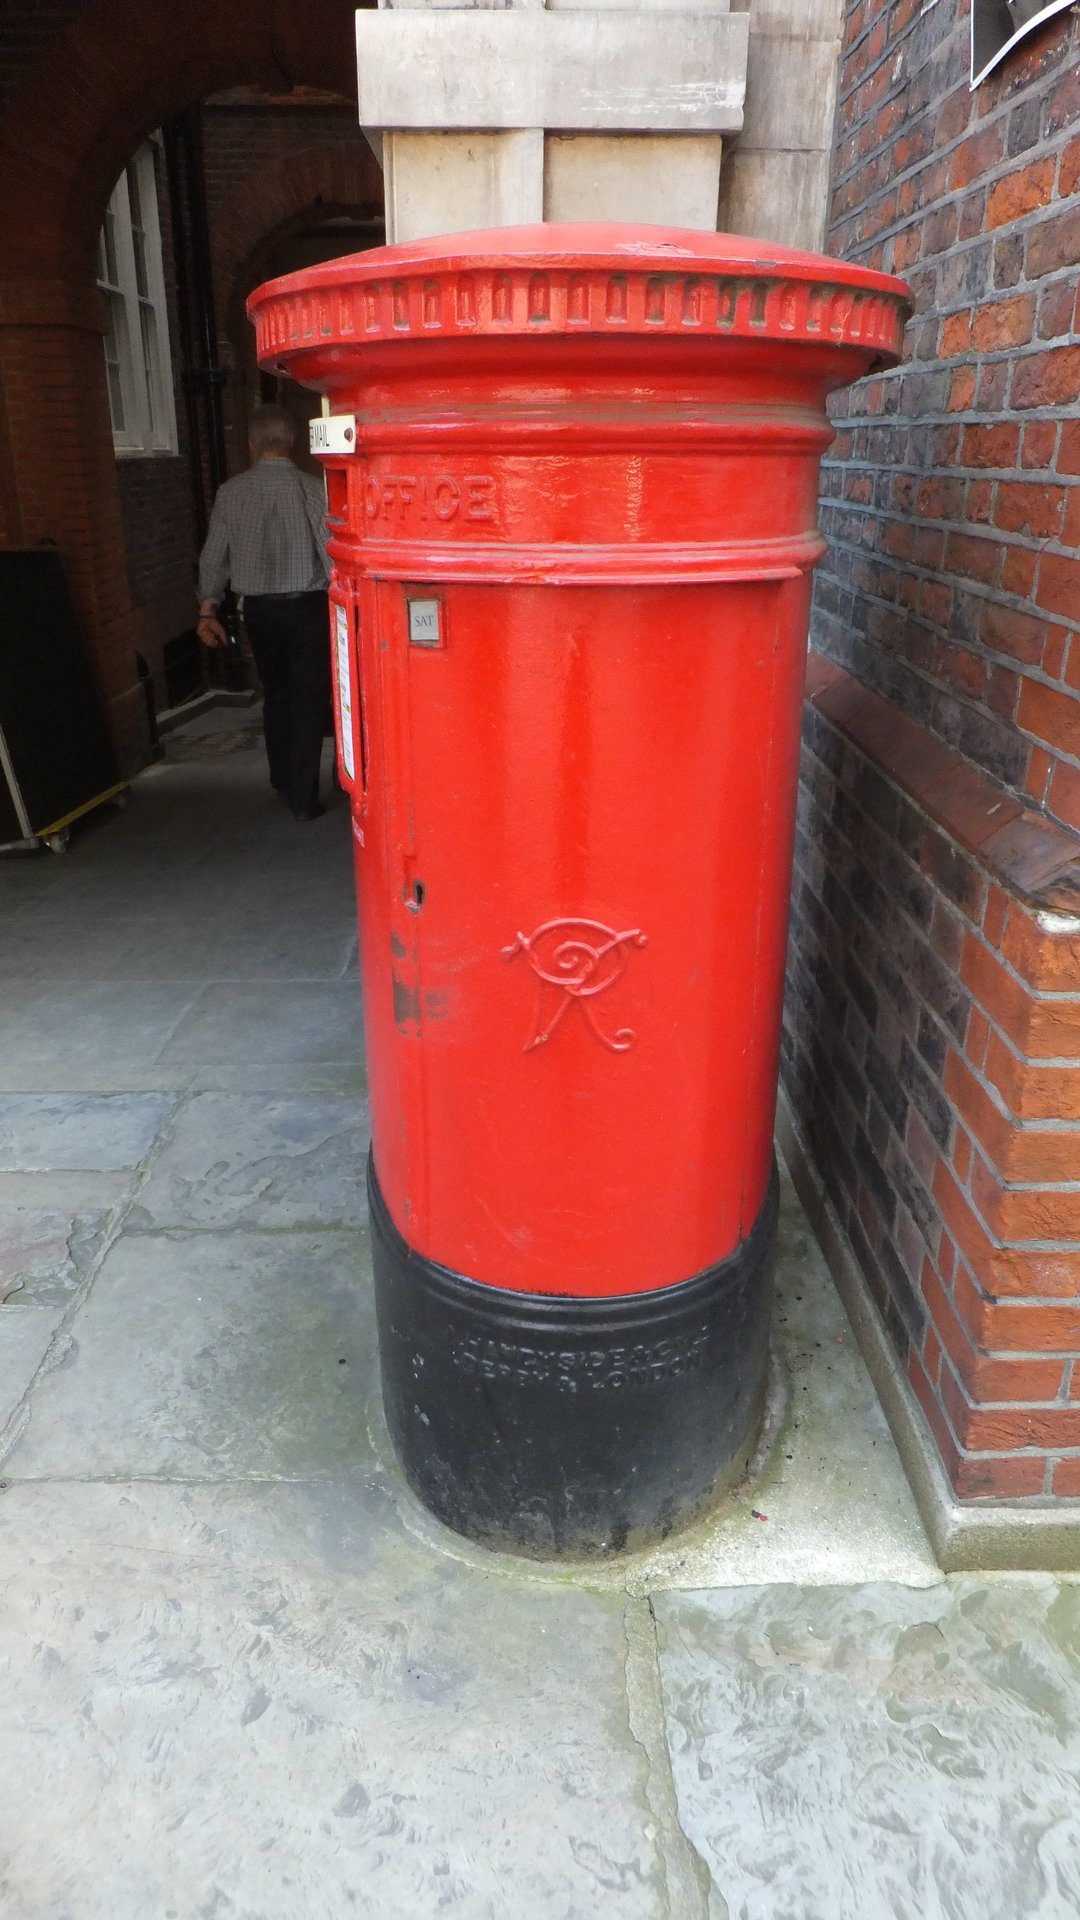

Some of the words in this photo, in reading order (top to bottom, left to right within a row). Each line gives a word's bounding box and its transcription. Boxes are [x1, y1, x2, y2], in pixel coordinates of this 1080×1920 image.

[363, 473, 498, 524] OFFICE
[414, 615, 434, 627] SAT
[591, 1348, 705, 1390] LONDON
